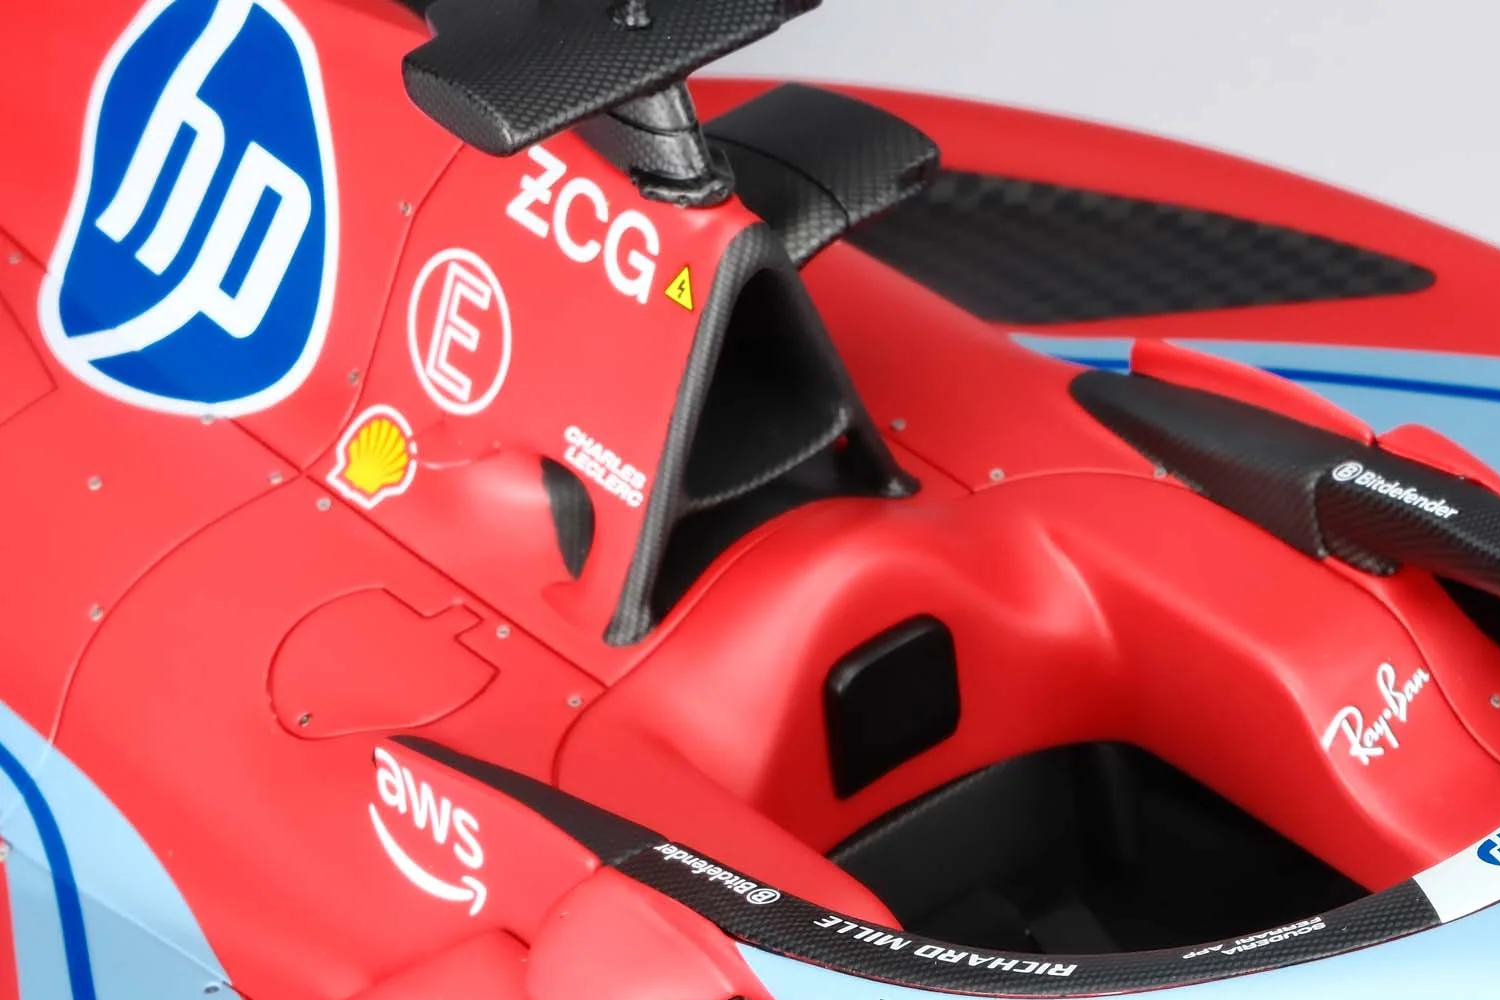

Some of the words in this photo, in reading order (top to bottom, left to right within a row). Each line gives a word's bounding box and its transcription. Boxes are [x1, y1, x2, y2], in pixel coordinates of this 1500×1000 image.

[60, 0, 311, 362] hp
[563, 425, 647, 490] CHARLES
[563, 446, 644, 508] LECLERC
[1354, 469, 1459, 519] Bitdefender
[374, 746, 485, 870] aws
[653, 843, 758, 894] Bitdefender
[814, 914, 909, 950] MILLE
[1182, 943, 1224, 960] APP
[1221, 921, 1327, 956] SCUDERIA
[1234, 916, 1322, 945] FERRARI
[914, 944, 1078, 977] RICHARD
